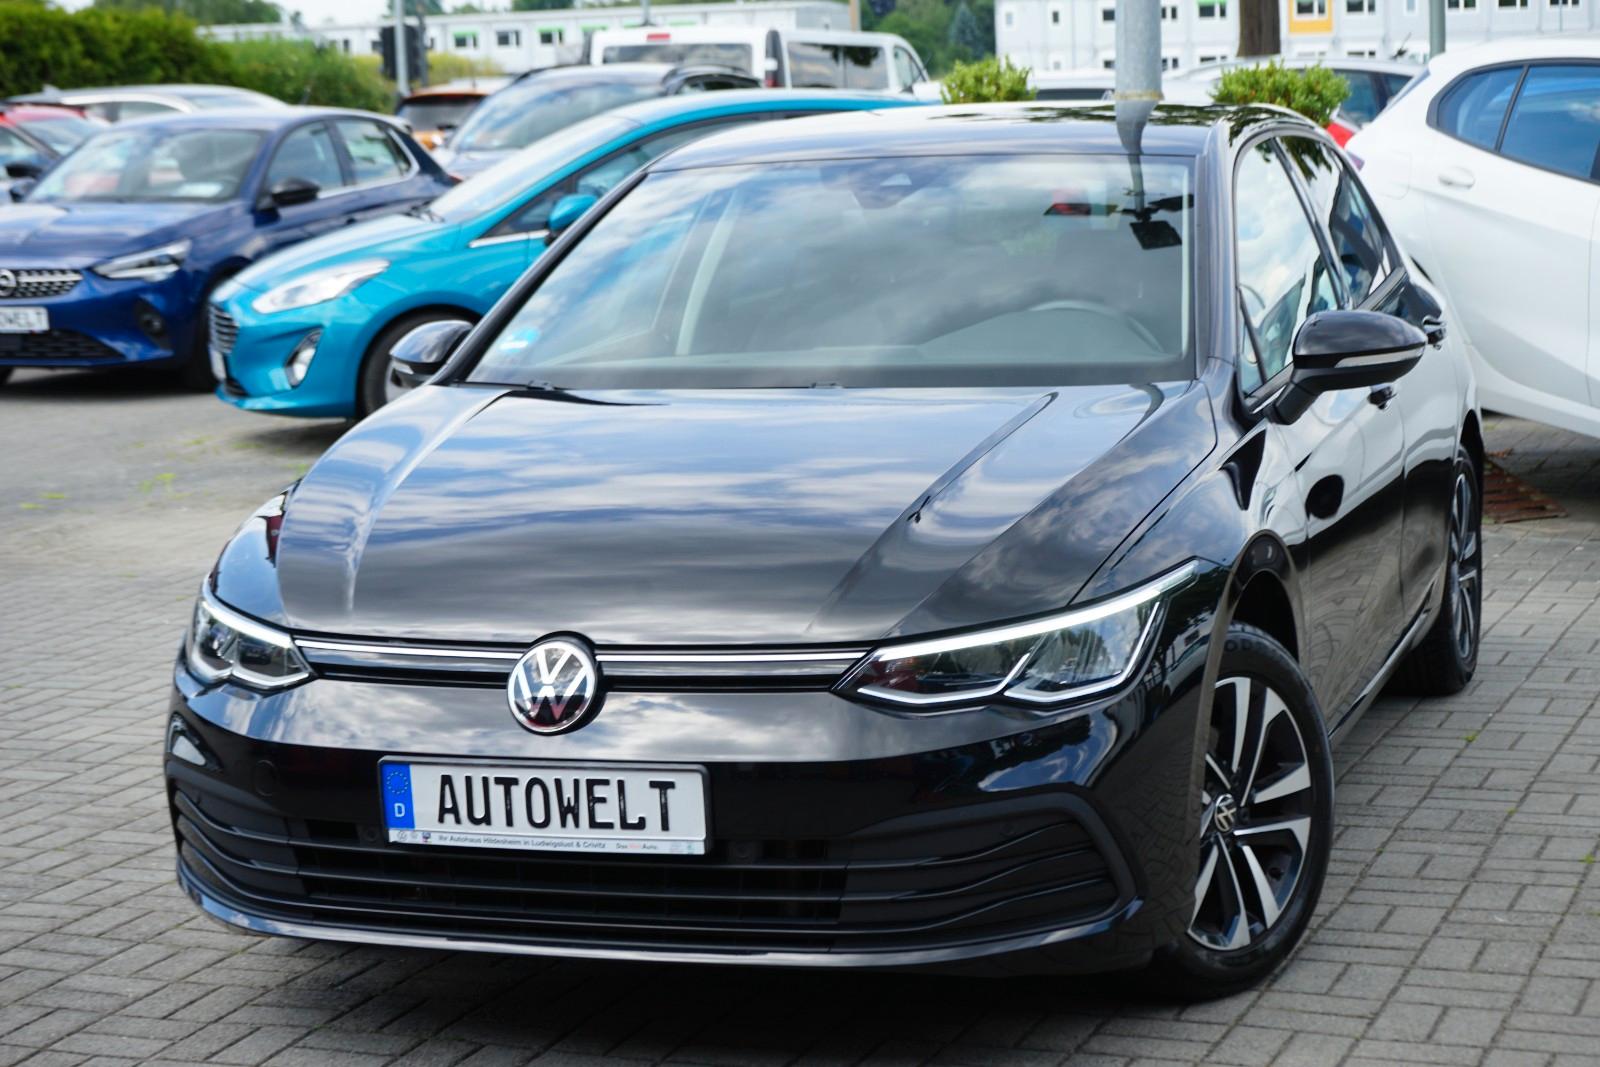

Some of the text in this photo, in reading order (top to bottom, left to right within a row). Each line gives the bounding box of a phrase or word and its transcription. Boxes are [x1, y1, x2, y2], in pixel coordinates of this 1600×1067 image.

[508, 640, 595, 732] VW
[394, 802, 406, 818] D
[438, 774, 676, 832] AUTOWELT
[450, 835, 482, 843] Autohaus
